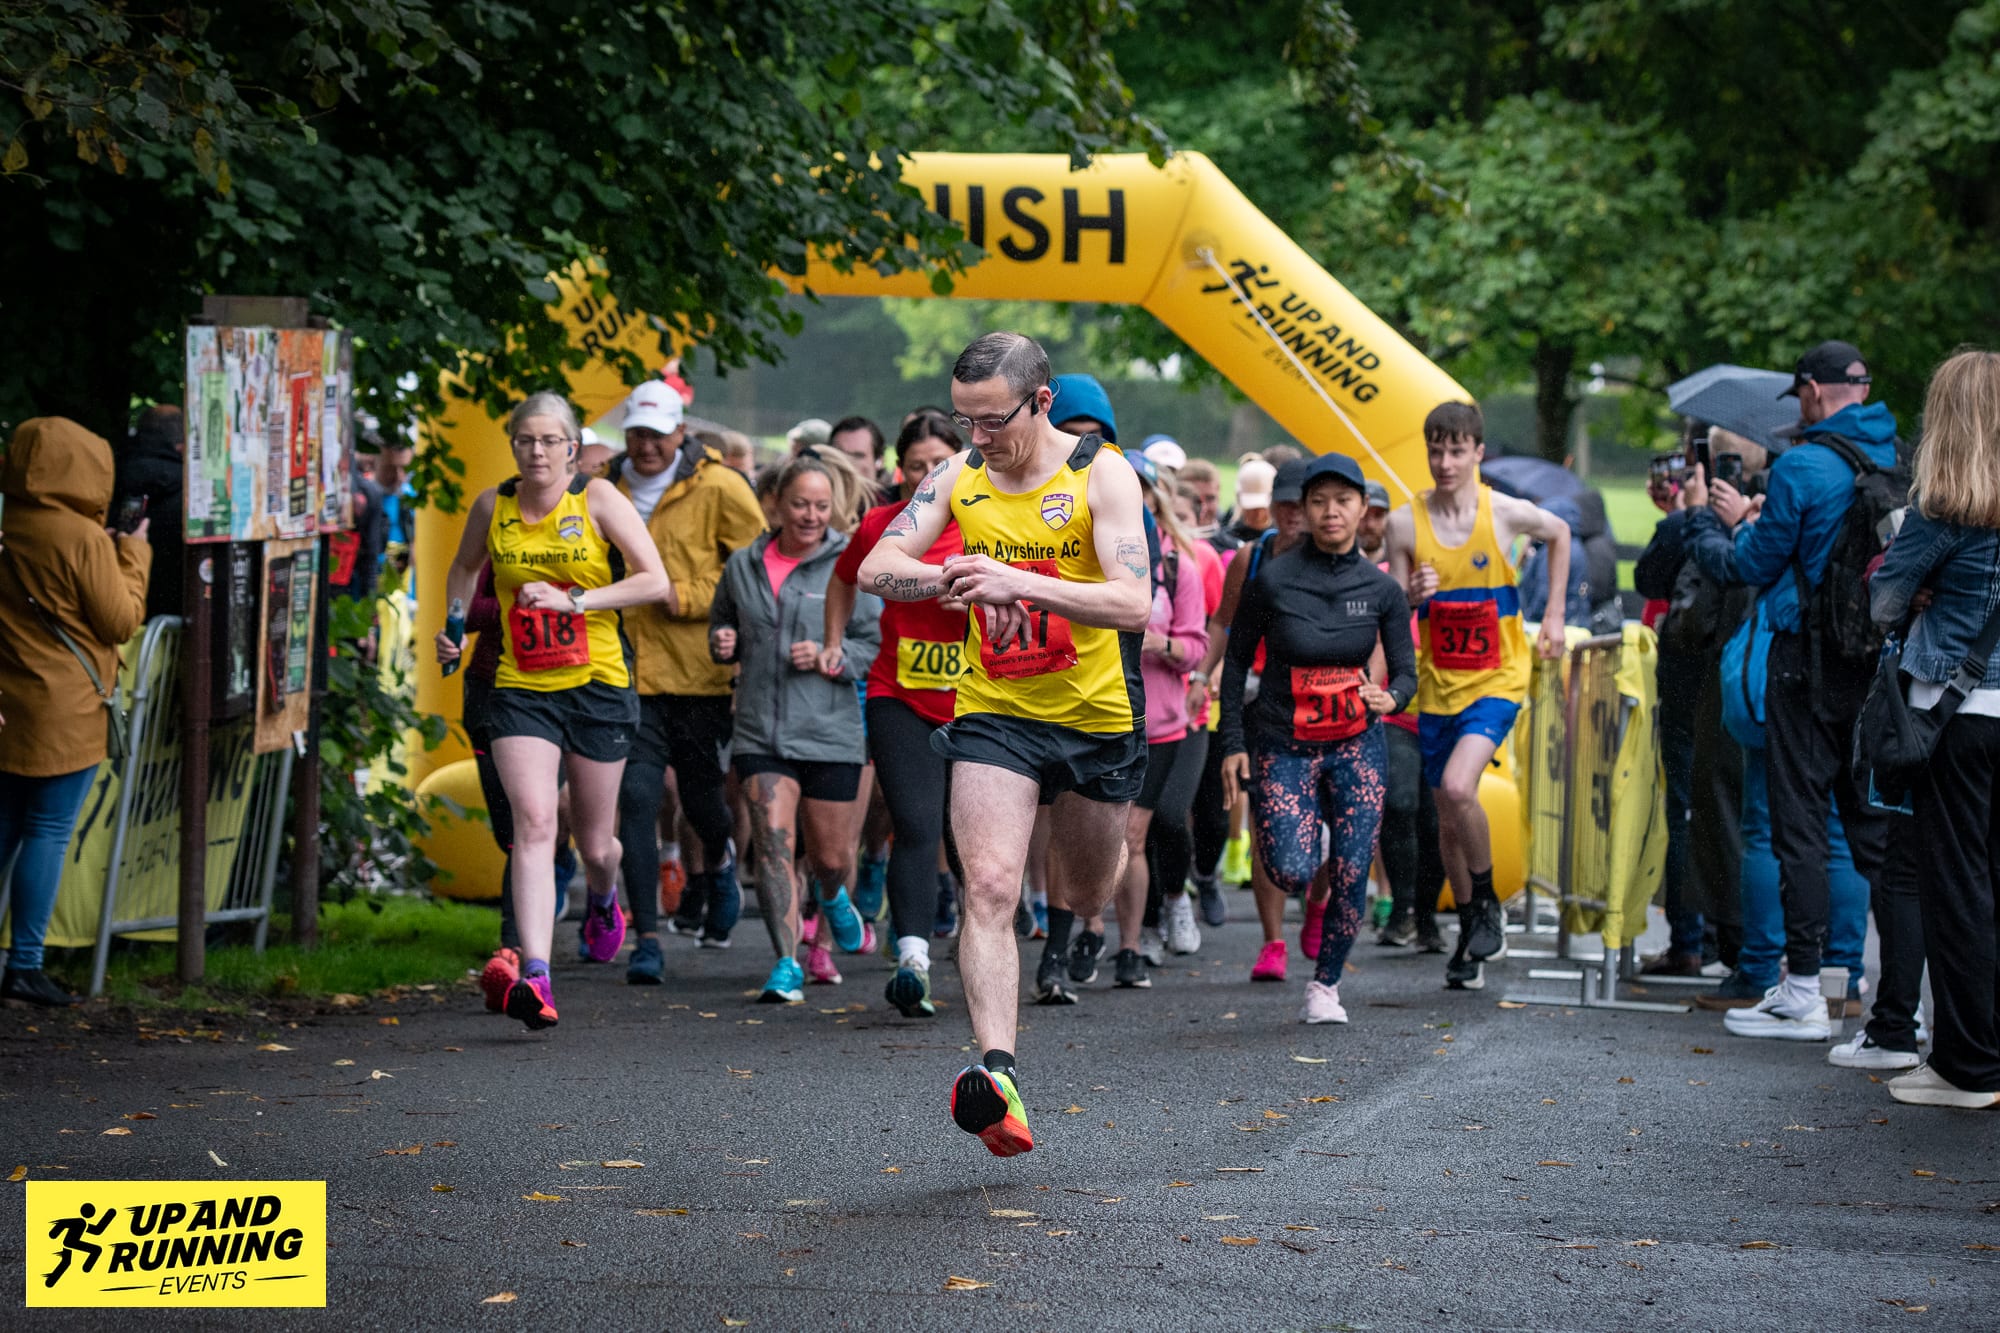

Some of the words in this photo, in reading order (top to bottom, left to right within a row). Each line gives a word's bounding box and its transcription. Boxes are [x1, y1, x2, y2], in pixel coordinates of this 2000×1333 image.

[1280, 292, 1323, 325] UP
[1315, 323, 1381, 371] AND
[1246, 302, 1381, 403] RUNNING
[520, 550, 569, 568] Ayrshire
[572, 547, 588, 562] AC
[994, 540, 1055, 562] Ayrshire
[1060, 539, 1081, 559] AC
[873, 572, 919, 594] Ryan
[520, 612, 576, 652] 318
[1440, 626, 1490, 655] 375
[910, 641, 962, 676] 208
[1018, 655, 1036, 663] Park
